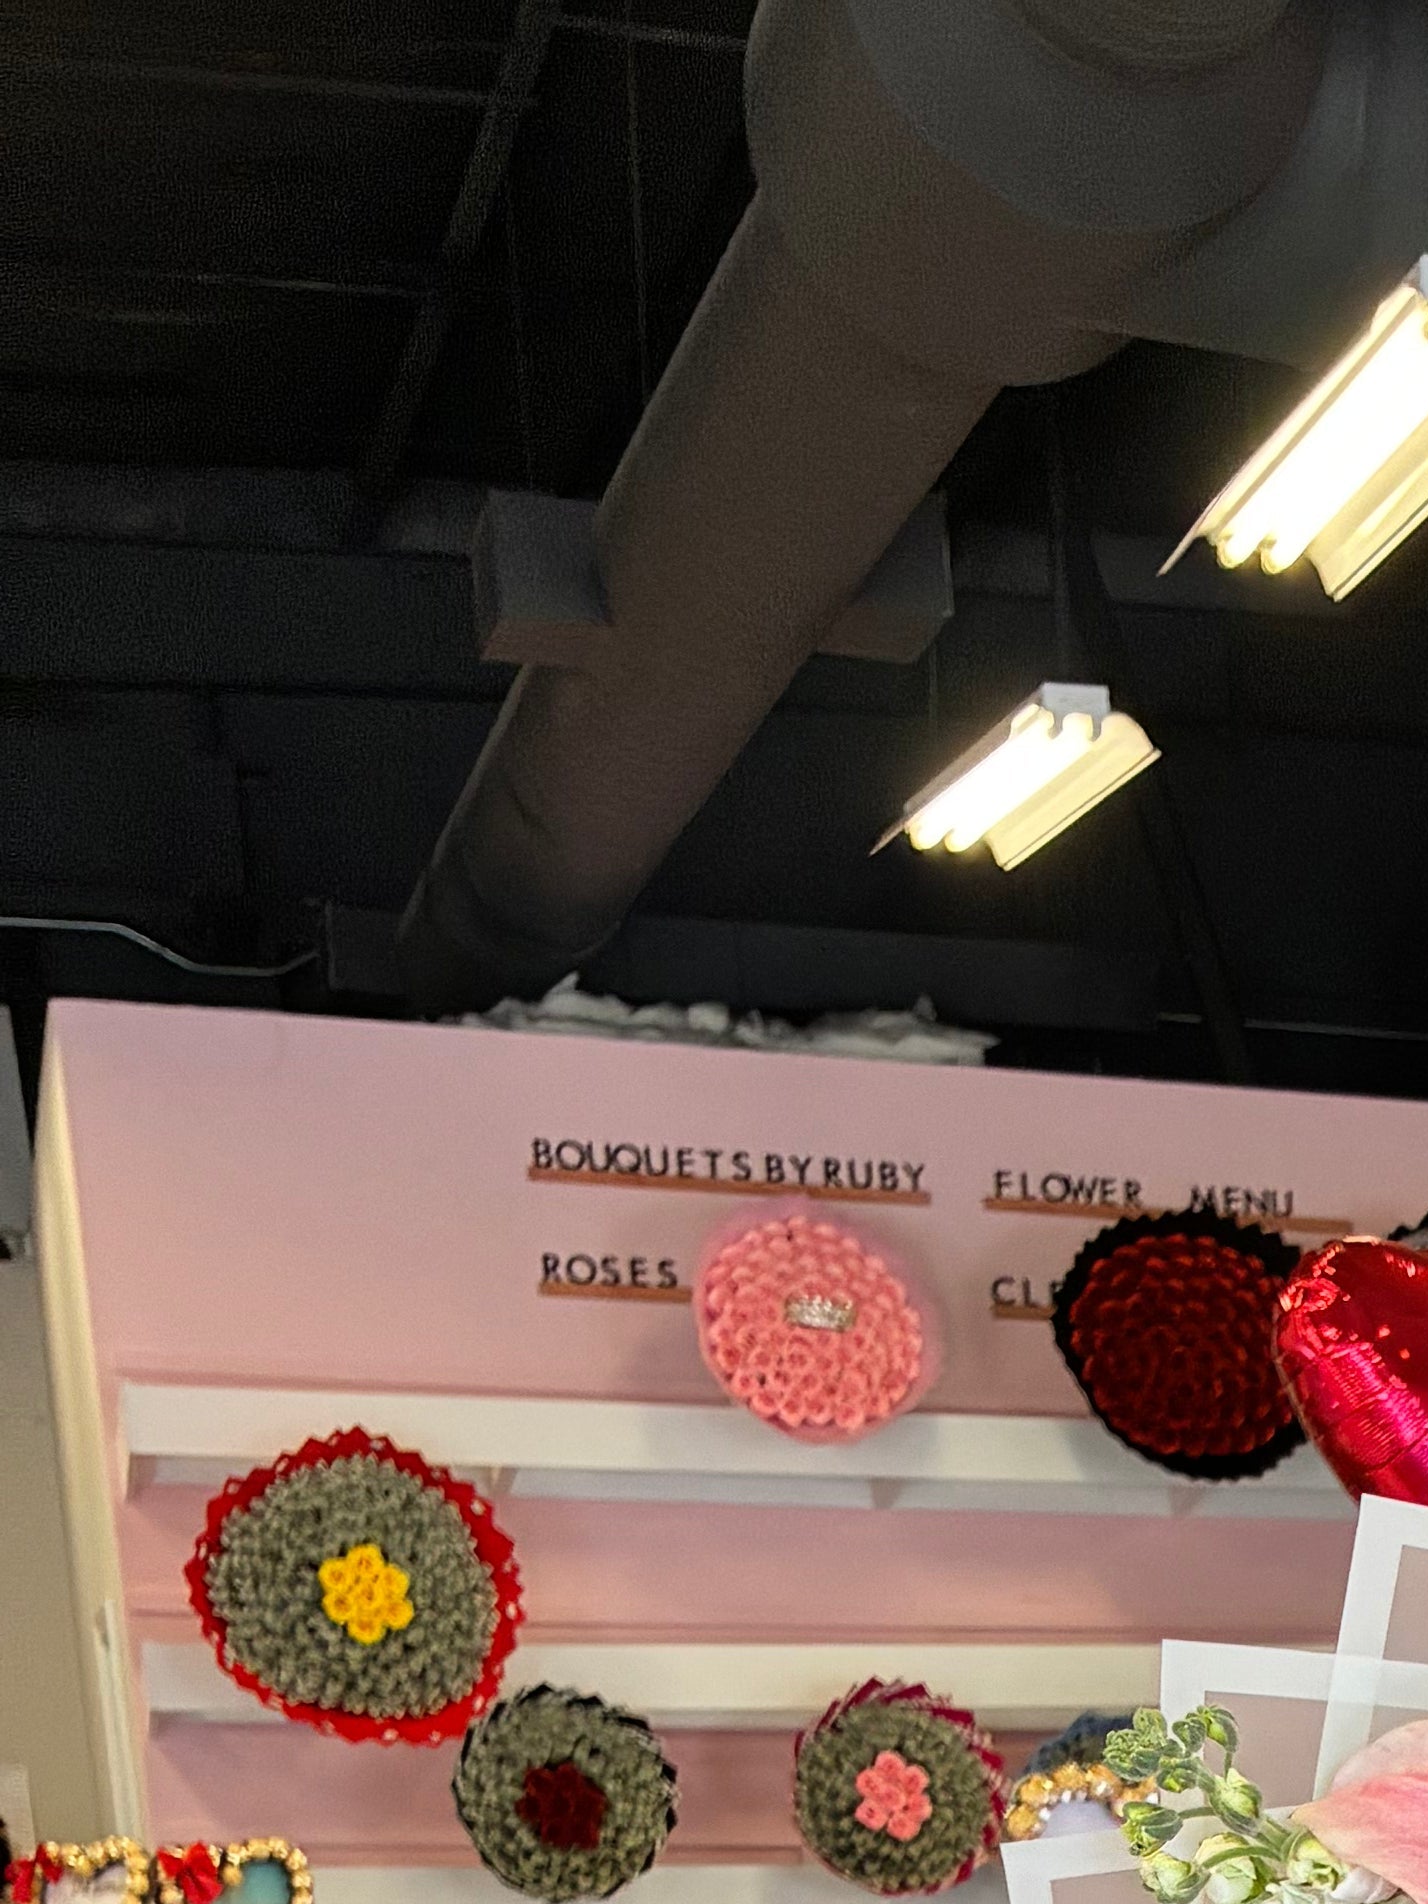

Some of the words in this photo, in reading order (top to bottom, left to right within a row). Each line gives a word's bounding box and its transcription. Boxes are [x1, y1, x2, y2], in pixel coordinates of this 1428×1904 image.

[531, 1137, 752, 1182] BOUQUETS
[764, 1150, 812, 1186] BY
[823, 1156, 926, 1193] RUBY
[993, 1170, 1143, 1208] FLOWER
[1190, 1185, 1294, 1218] MENU
[541, 1251, 679, 1290] ROSES
